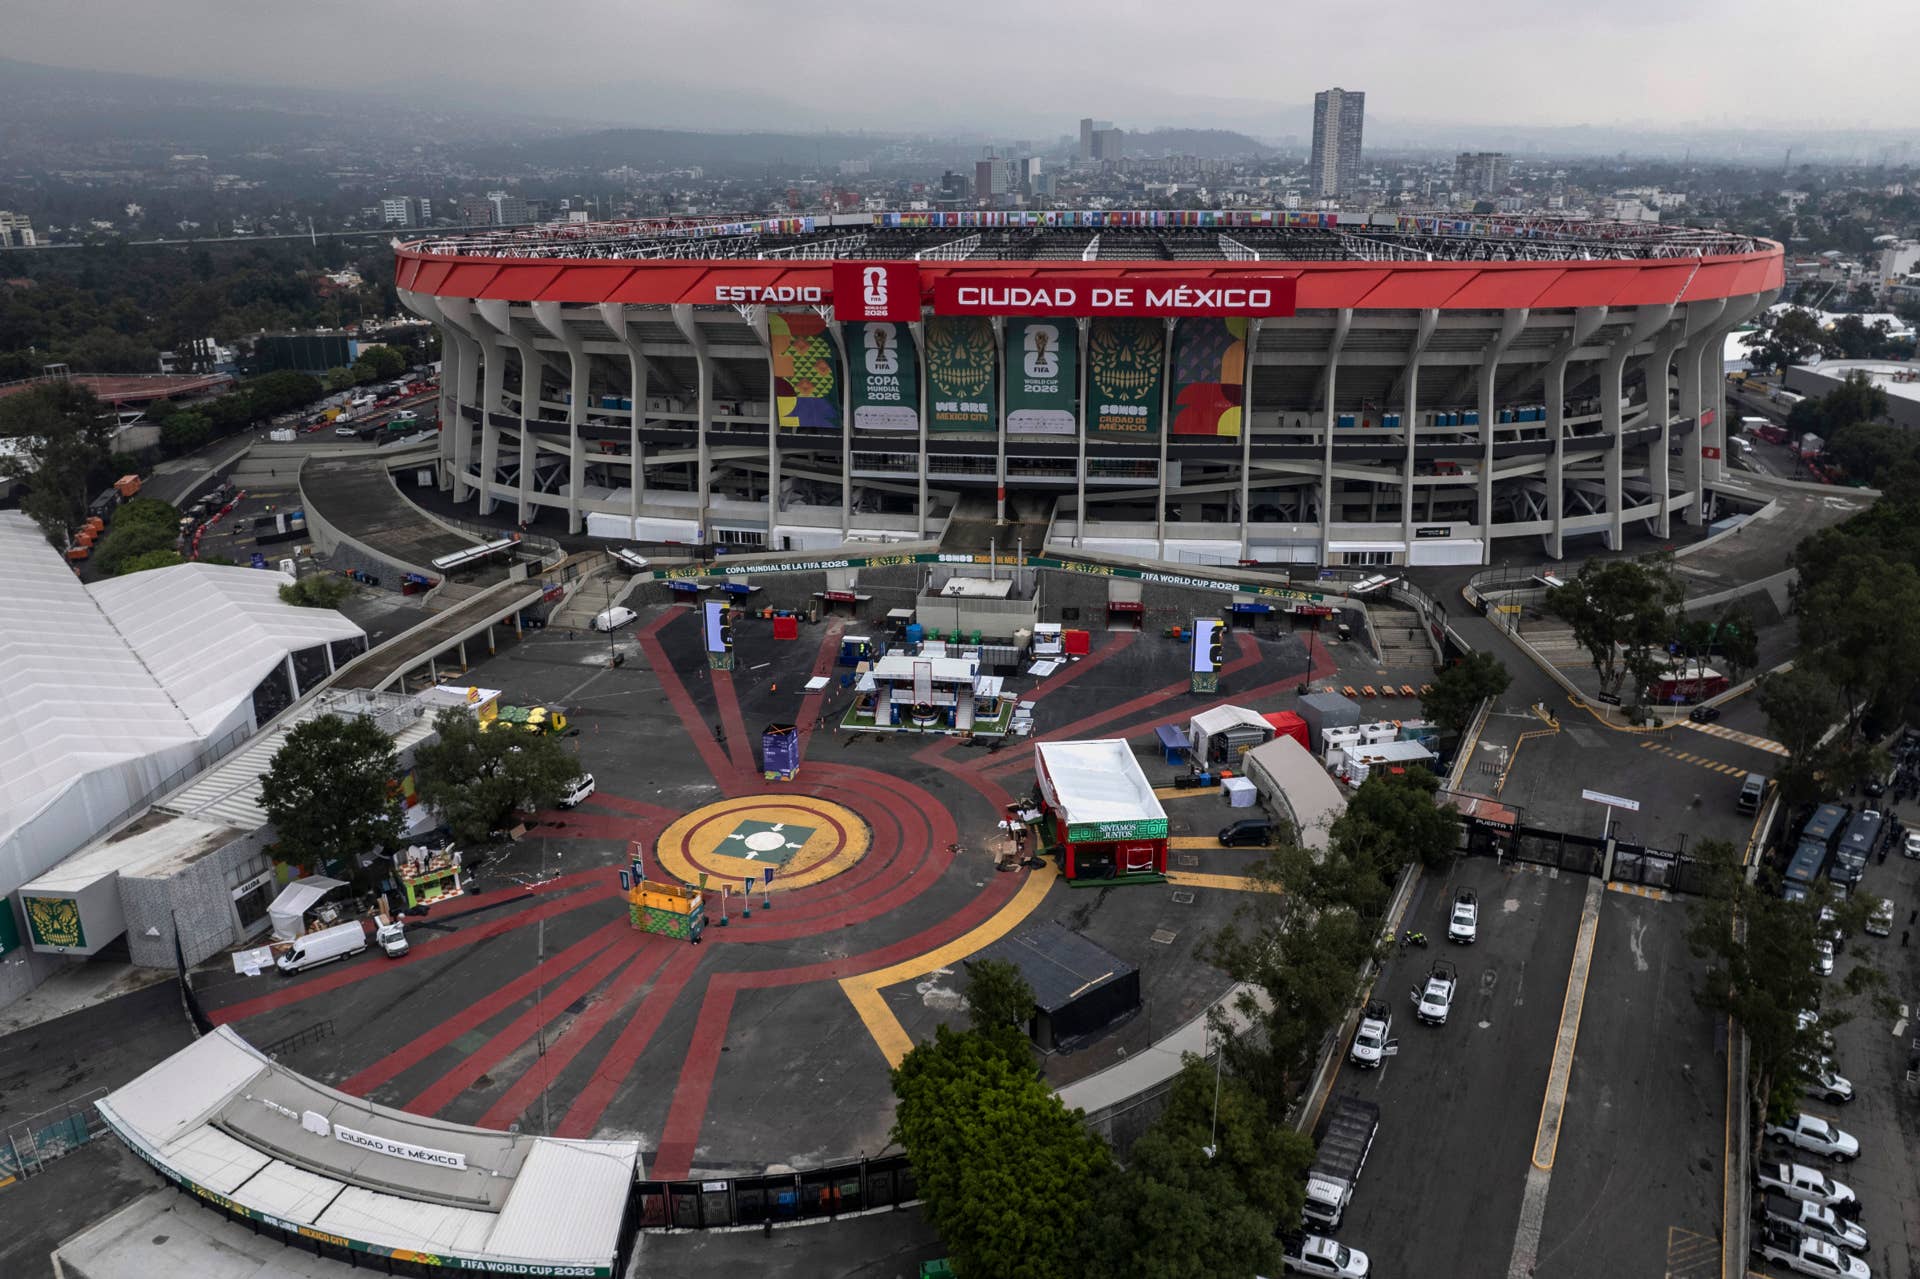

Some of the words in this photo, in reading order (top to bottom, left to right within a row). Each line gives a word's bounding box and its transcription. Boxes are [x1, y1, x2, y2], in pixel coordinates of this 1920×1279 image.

[715, 286, 821, 302] ESTADIO
[957, 287, 1077, 306] CIUDAD
[1091, 289, 1133, 307] DE
[1145, 285, 1271, 308] MÉXICO
[866, 376, 900, 386] COPA
[1024, 385, 1058, 393] 2026
[867, 393, 901, 401] 2026
[935, 402, 958, 412] WE
[959, 402, 988, 413] ARE
[1099, 405, 1149, 416] SOMOS
[935, 413, 969, 421] MEXICO
[970, 413, 988, 422] CITY
[1134, 416, 1147, 424] DE
[725, 566, 746, 574] COPA
[746, 564, 780, 573] MUNDIAL
[781, 563, 790, 571] DE
[791, 562, 802, 570] LA
[803, 561, 820, 569] FIFA
[821, 560, 849, 568] 2026
[1140, 572, 1159, 582] FIFA
[1160, 575, 1191, 586] WORLD
[1192, 578, 1209, 588] CUP
[1210, 581, 1239, 592] 2026
[1476, 819, 1506, 829] PUERTA
[1103, 831, 1133, 839] JUNTOS
[341, 1132, 383, 1150] CIUDAD
[388, 1144, 404, 1155] DE
[408, 1150, 457, 1166] MÉXICO
[298, 1226, 330, 1242] MEXICO
[330, 1235, 350, 1247] CITY
[460, 1259, 485, 1270] FIFA
[487, 1262, 528, 1274] WORLD
[529, 1265, 552, 1276] CUP
[553, 1267, 596, 1277] 2026
